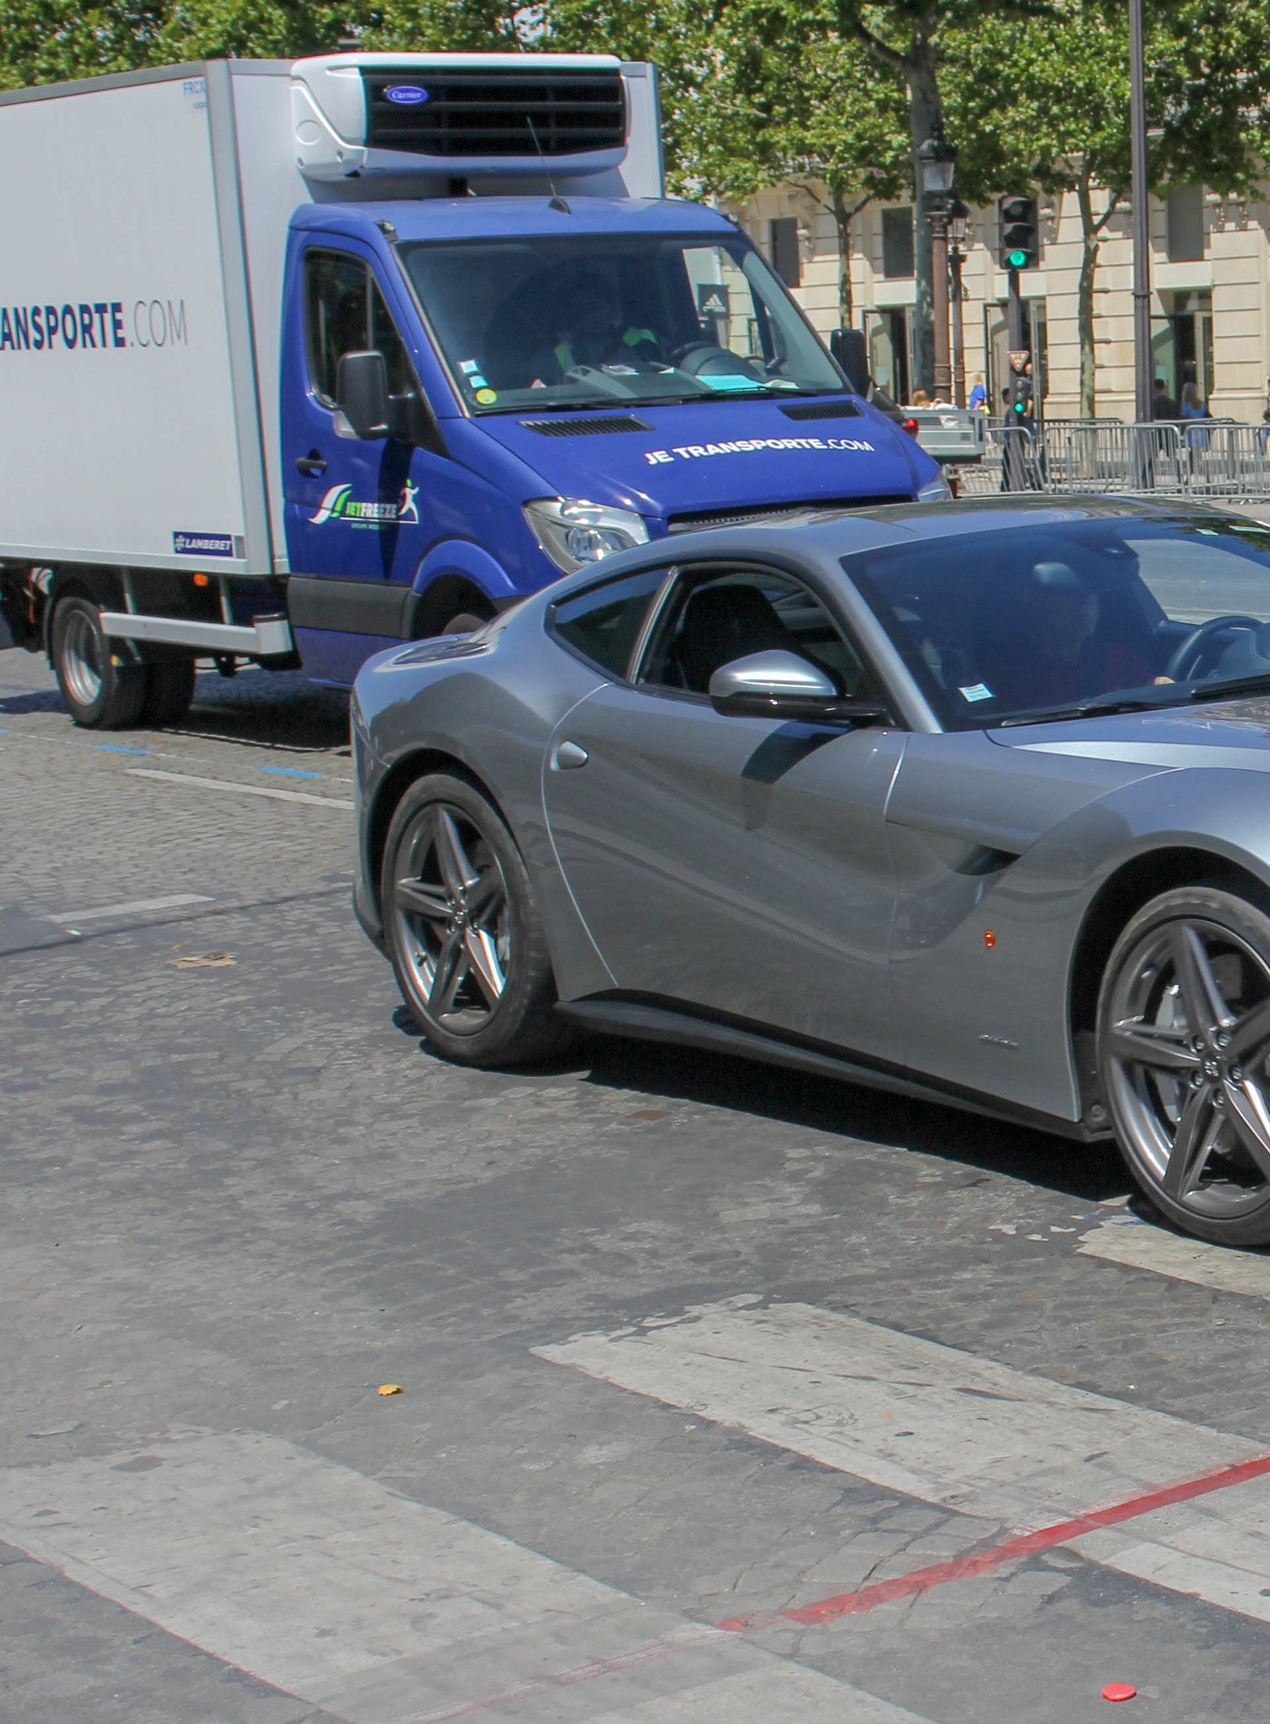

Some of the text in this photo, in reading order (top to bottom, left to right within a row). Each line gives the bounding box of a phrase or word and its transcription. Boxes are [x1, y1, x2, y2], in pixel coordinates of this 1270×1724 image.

[644, 437, 875, 466] JE TRANSPORTE.COM
[345, 501, 397, 518] JETFREEZE
[185, 538, 232, 551] LAMBERET
